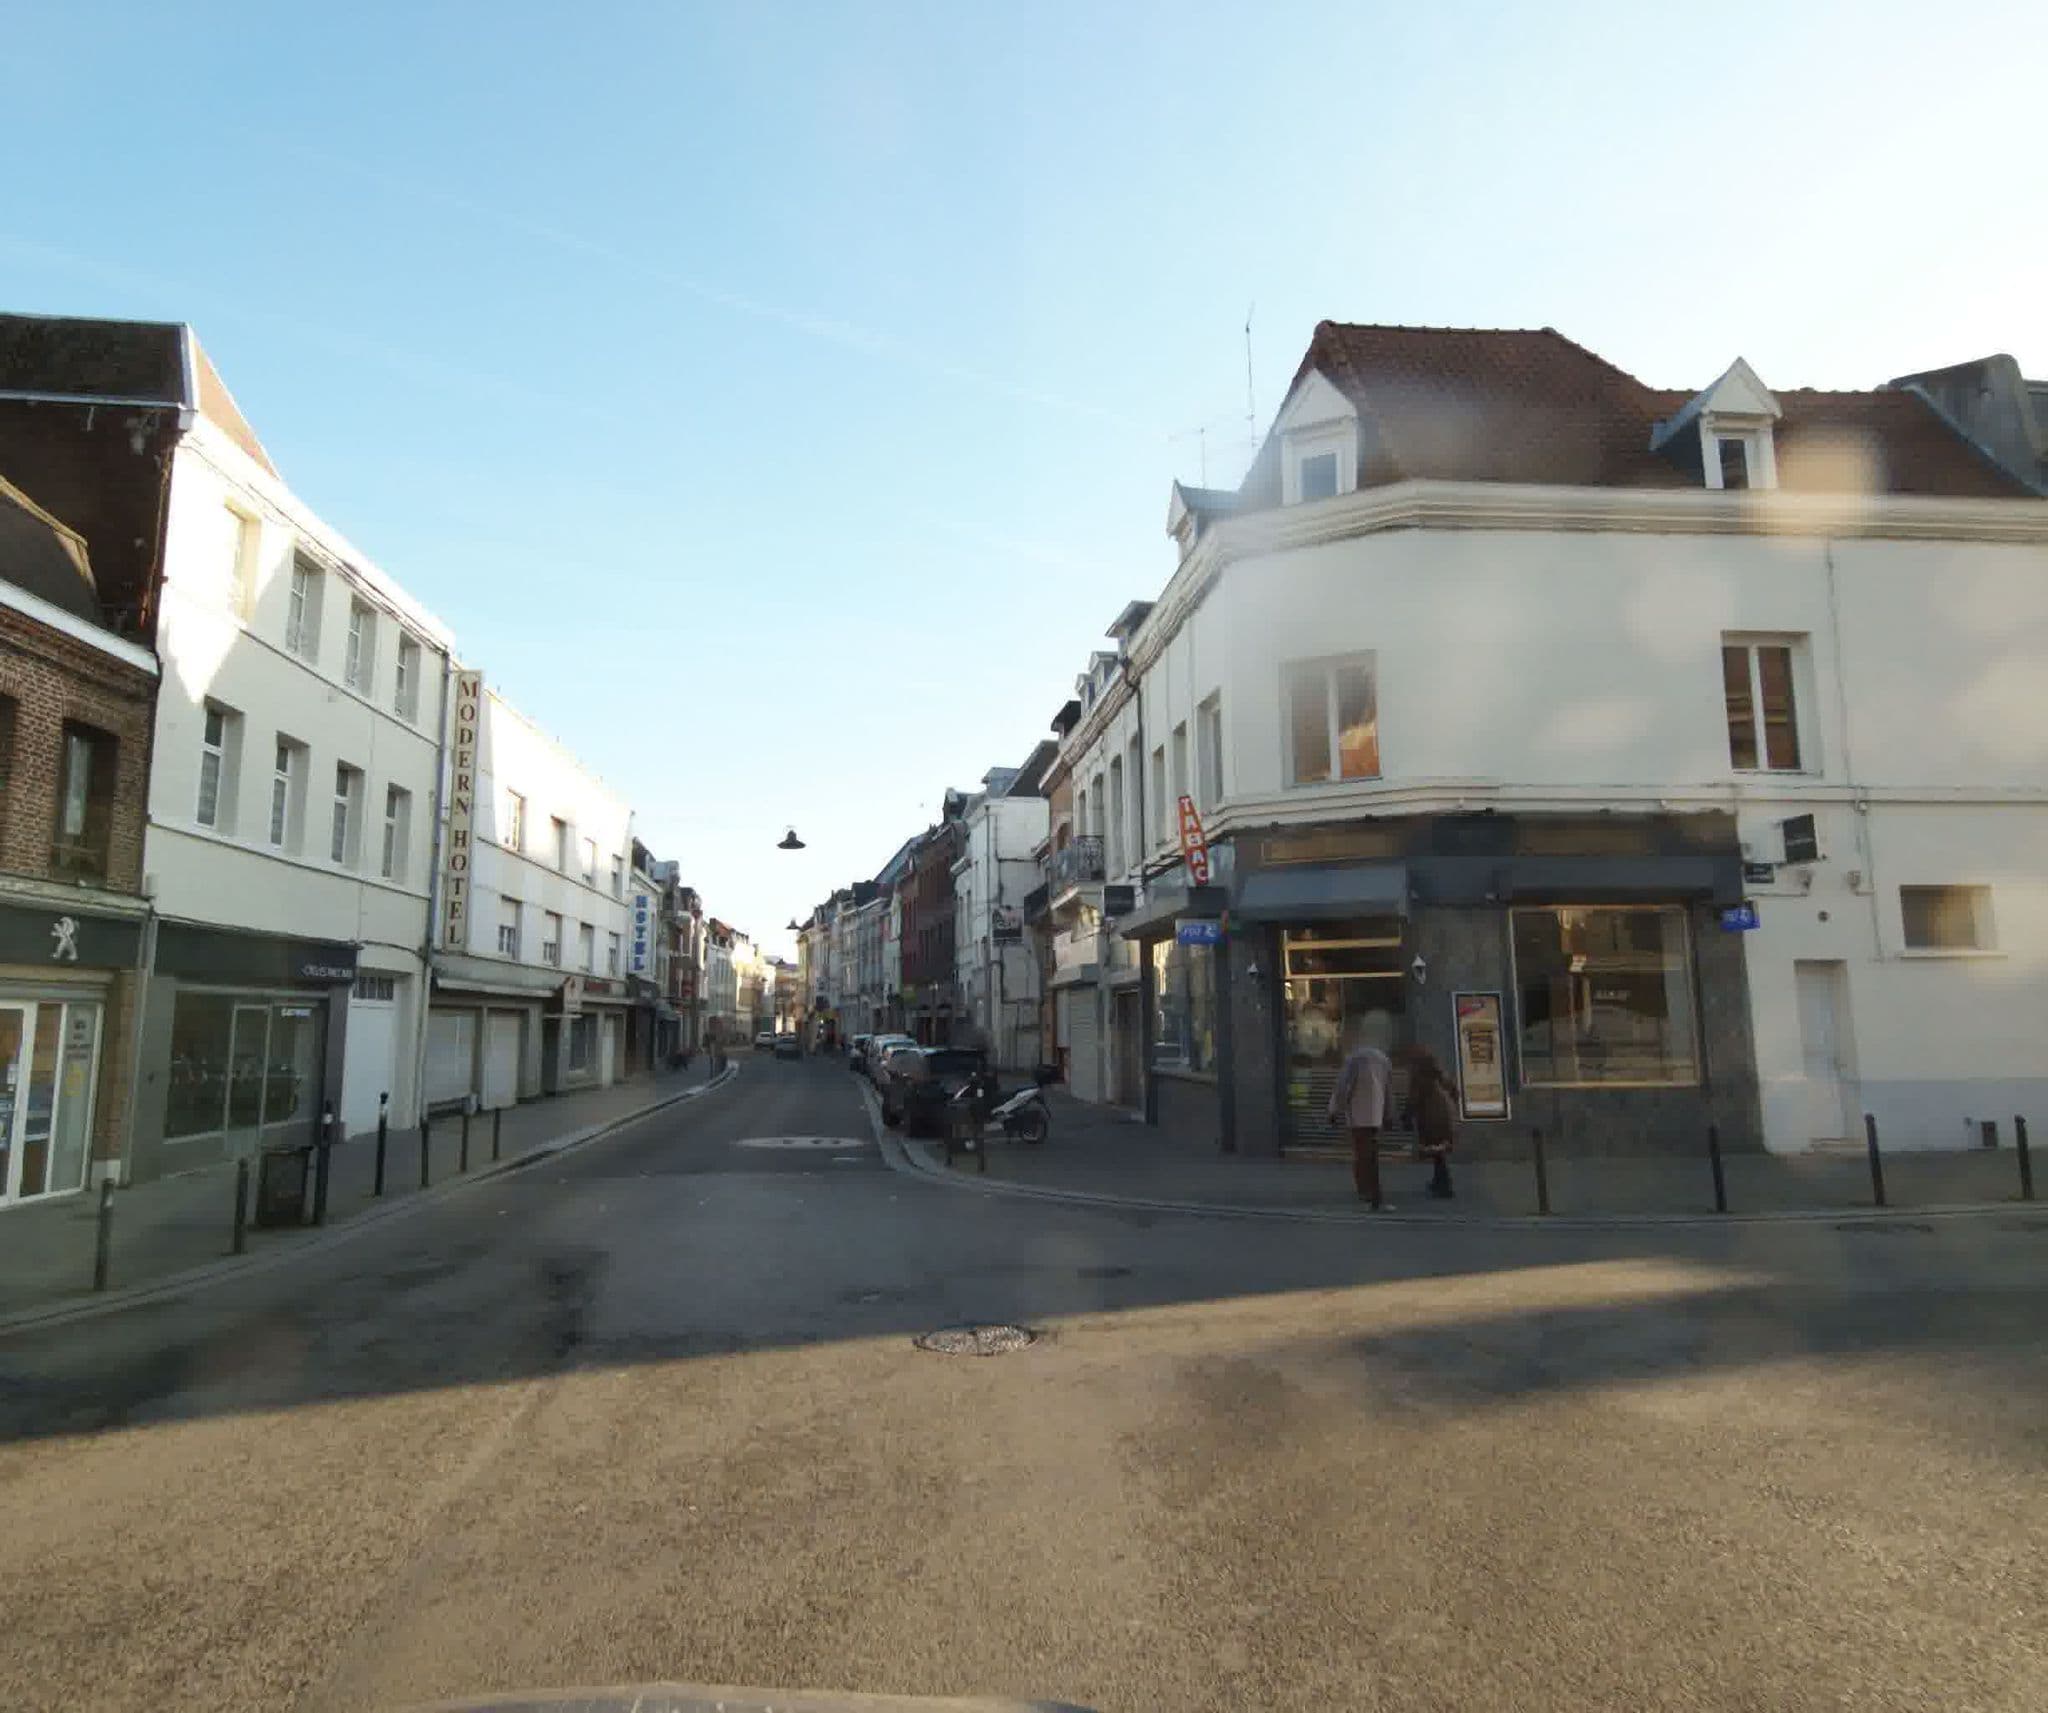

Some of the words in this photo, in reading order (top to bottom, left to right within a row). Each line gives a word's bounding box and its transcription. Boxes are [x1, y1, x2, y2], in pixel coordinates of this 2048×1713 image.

[456, 679, 478, 816] MODERN
[449, 829, 468, 945] HOTEL
[1181, 797, 1208, 881] TABAC
[634, 895, 648, 970] HOTEL
